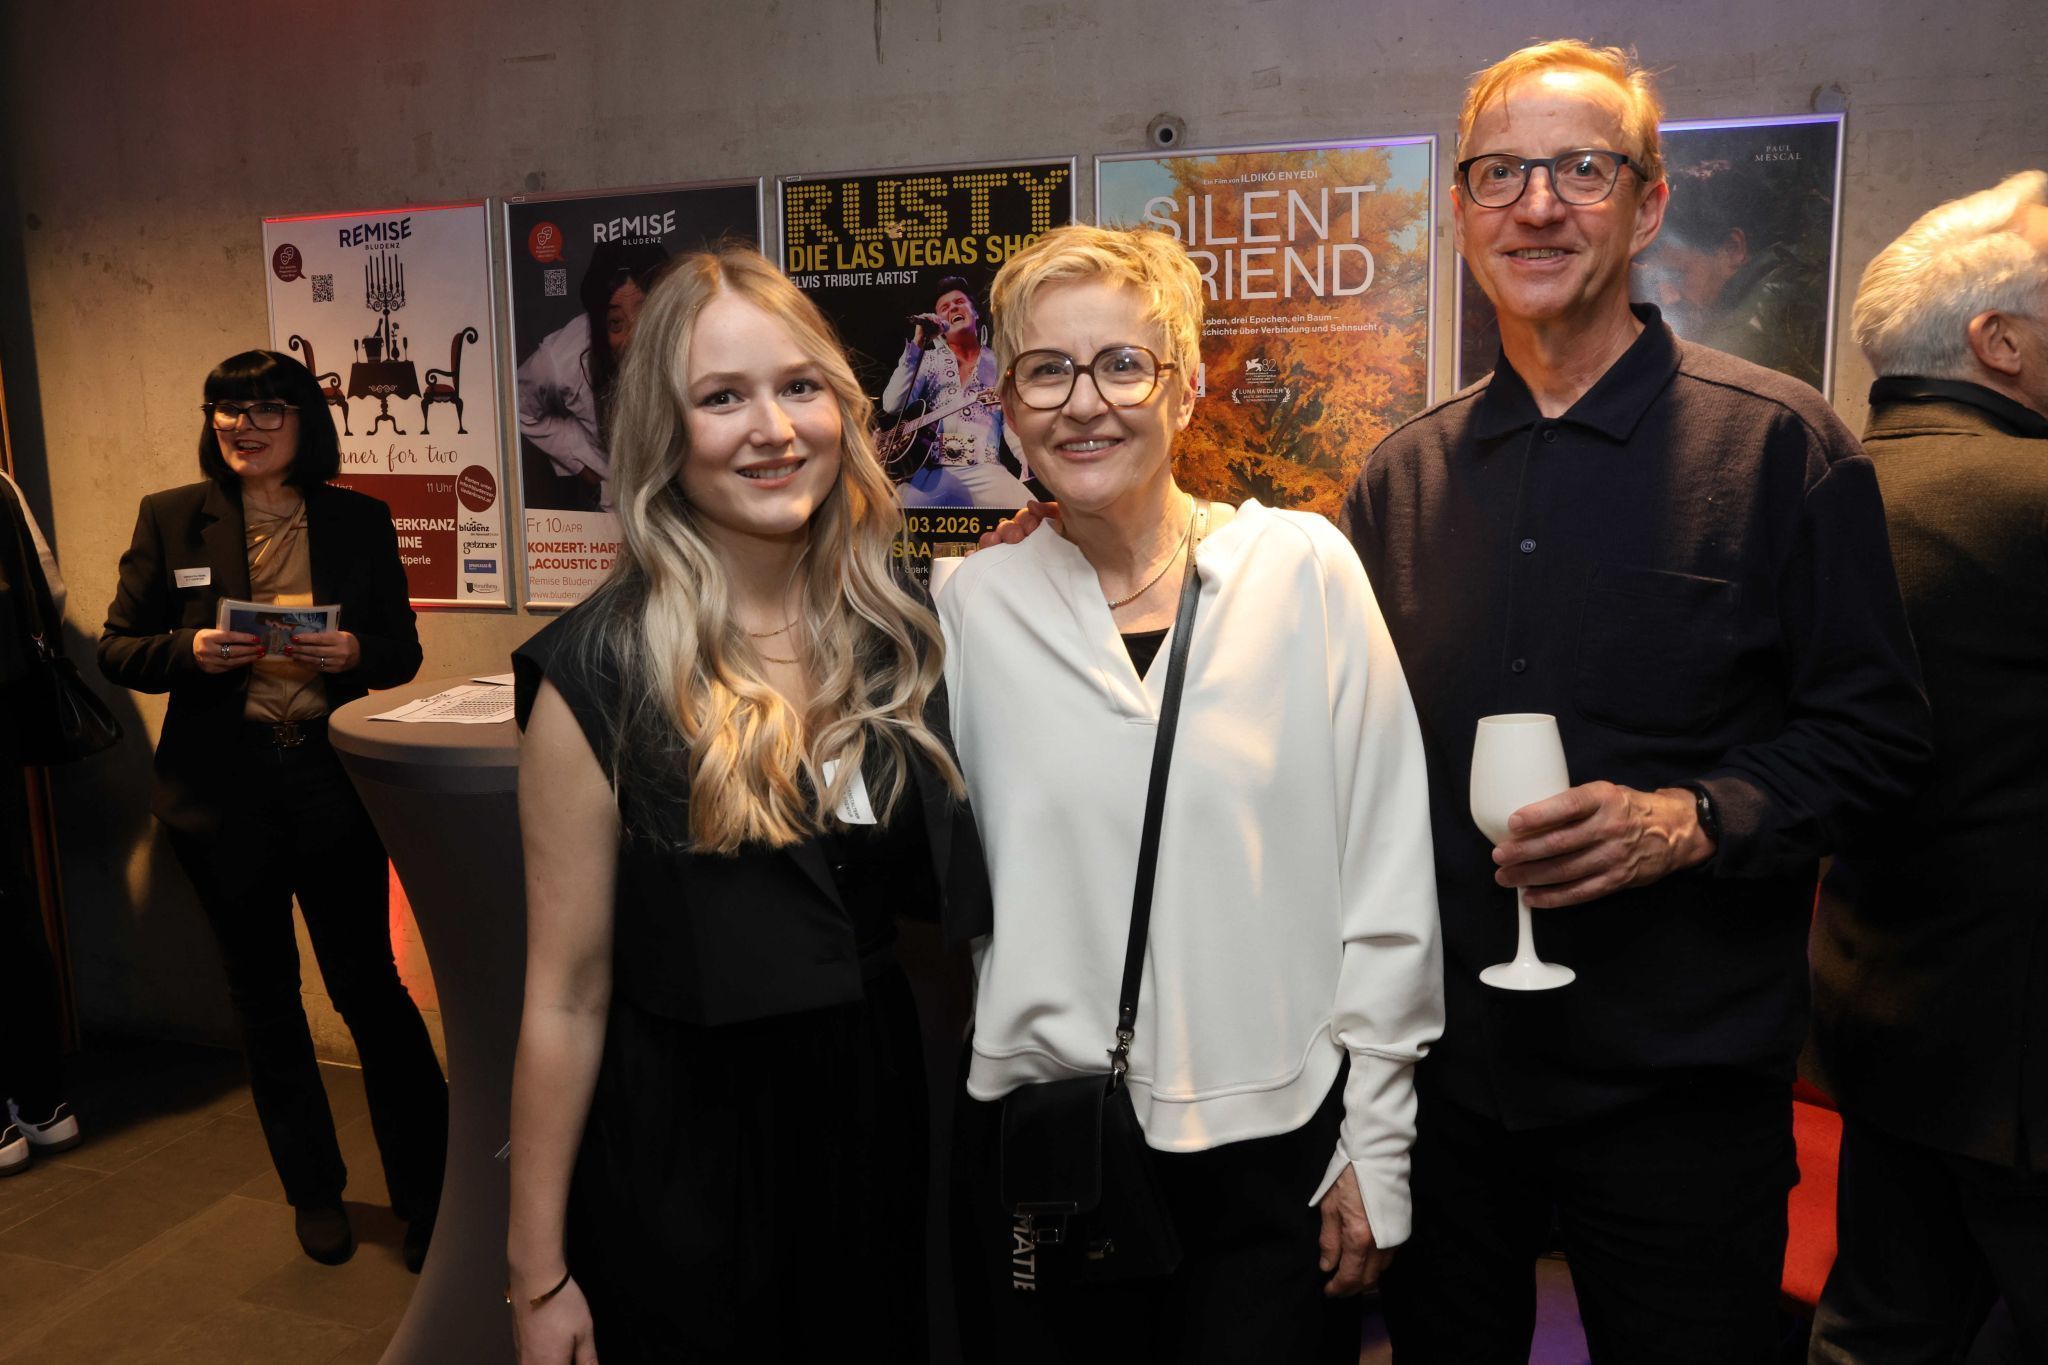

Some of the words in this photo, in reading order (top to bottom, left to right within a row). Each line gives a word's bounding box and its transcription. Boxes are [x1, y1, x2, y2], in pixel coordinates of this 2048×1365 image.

[1754, 152, 1802, 162] MESCAL
[1241, 171, 1276, 183] ILDIKÓ
[1278, 170, 1318, 181] ENYEDI
[786, 169, 1070, 245] RUSTY
[1144, 185, 1376, 247] SILENT
[339, 217, 412, 248] REMISE
[593, 209, 676, 244] REMISE
[364, 242, 400, 251] BLUDENZ
[622, 236, 662, 246] BLUDENZ
[789, 244, 829, 272] DIE
[837, 241, 885, 270] LAS
[892, 236, 978, 268] VEGAS
[986, 233, 1040, 264] SHO
[1186, 243, 1375, 301] RIEND
[823, 272, 873, 288] TRIBUTE
[876, 270, 919, 286] ARTIST
[1231, 316, 1248, 324] drei
[1250, 315, 1290, 326] Epochen,
[1291, 314, 1305, 322] ein
[1307, 313, 1332, 322] Baum
[1202, 327, 1238, 336] schichte
[1239, 326, 1259, 335] über
[1260, 325, 1310, 335] Verbindung
[1311, 324, 1328, 333] und
[1330, 322, 1377, 332] Sehnsucht
[1261, 358, 1277, 371] 82
[340, 449, 379, 464] nner
[385, 443, 418, 473] for
[425, 444, 458, 463] two
[426, 482, 433, 492] 11
[436, 482, 453, 493] Uhr
[392, 518, 456, 531] ERKRANZ
[458, 524, 490, 532] bludenz
[526, 517, 542, 533] Fr
[463, 540, 498, 555] getzner
[527, 542, 587, 554] KONZERT:
[401, 554, 432, 567] tiperle
[529, 576, 560, 586] Remise
[562, 576, 592, 586] Bluden
